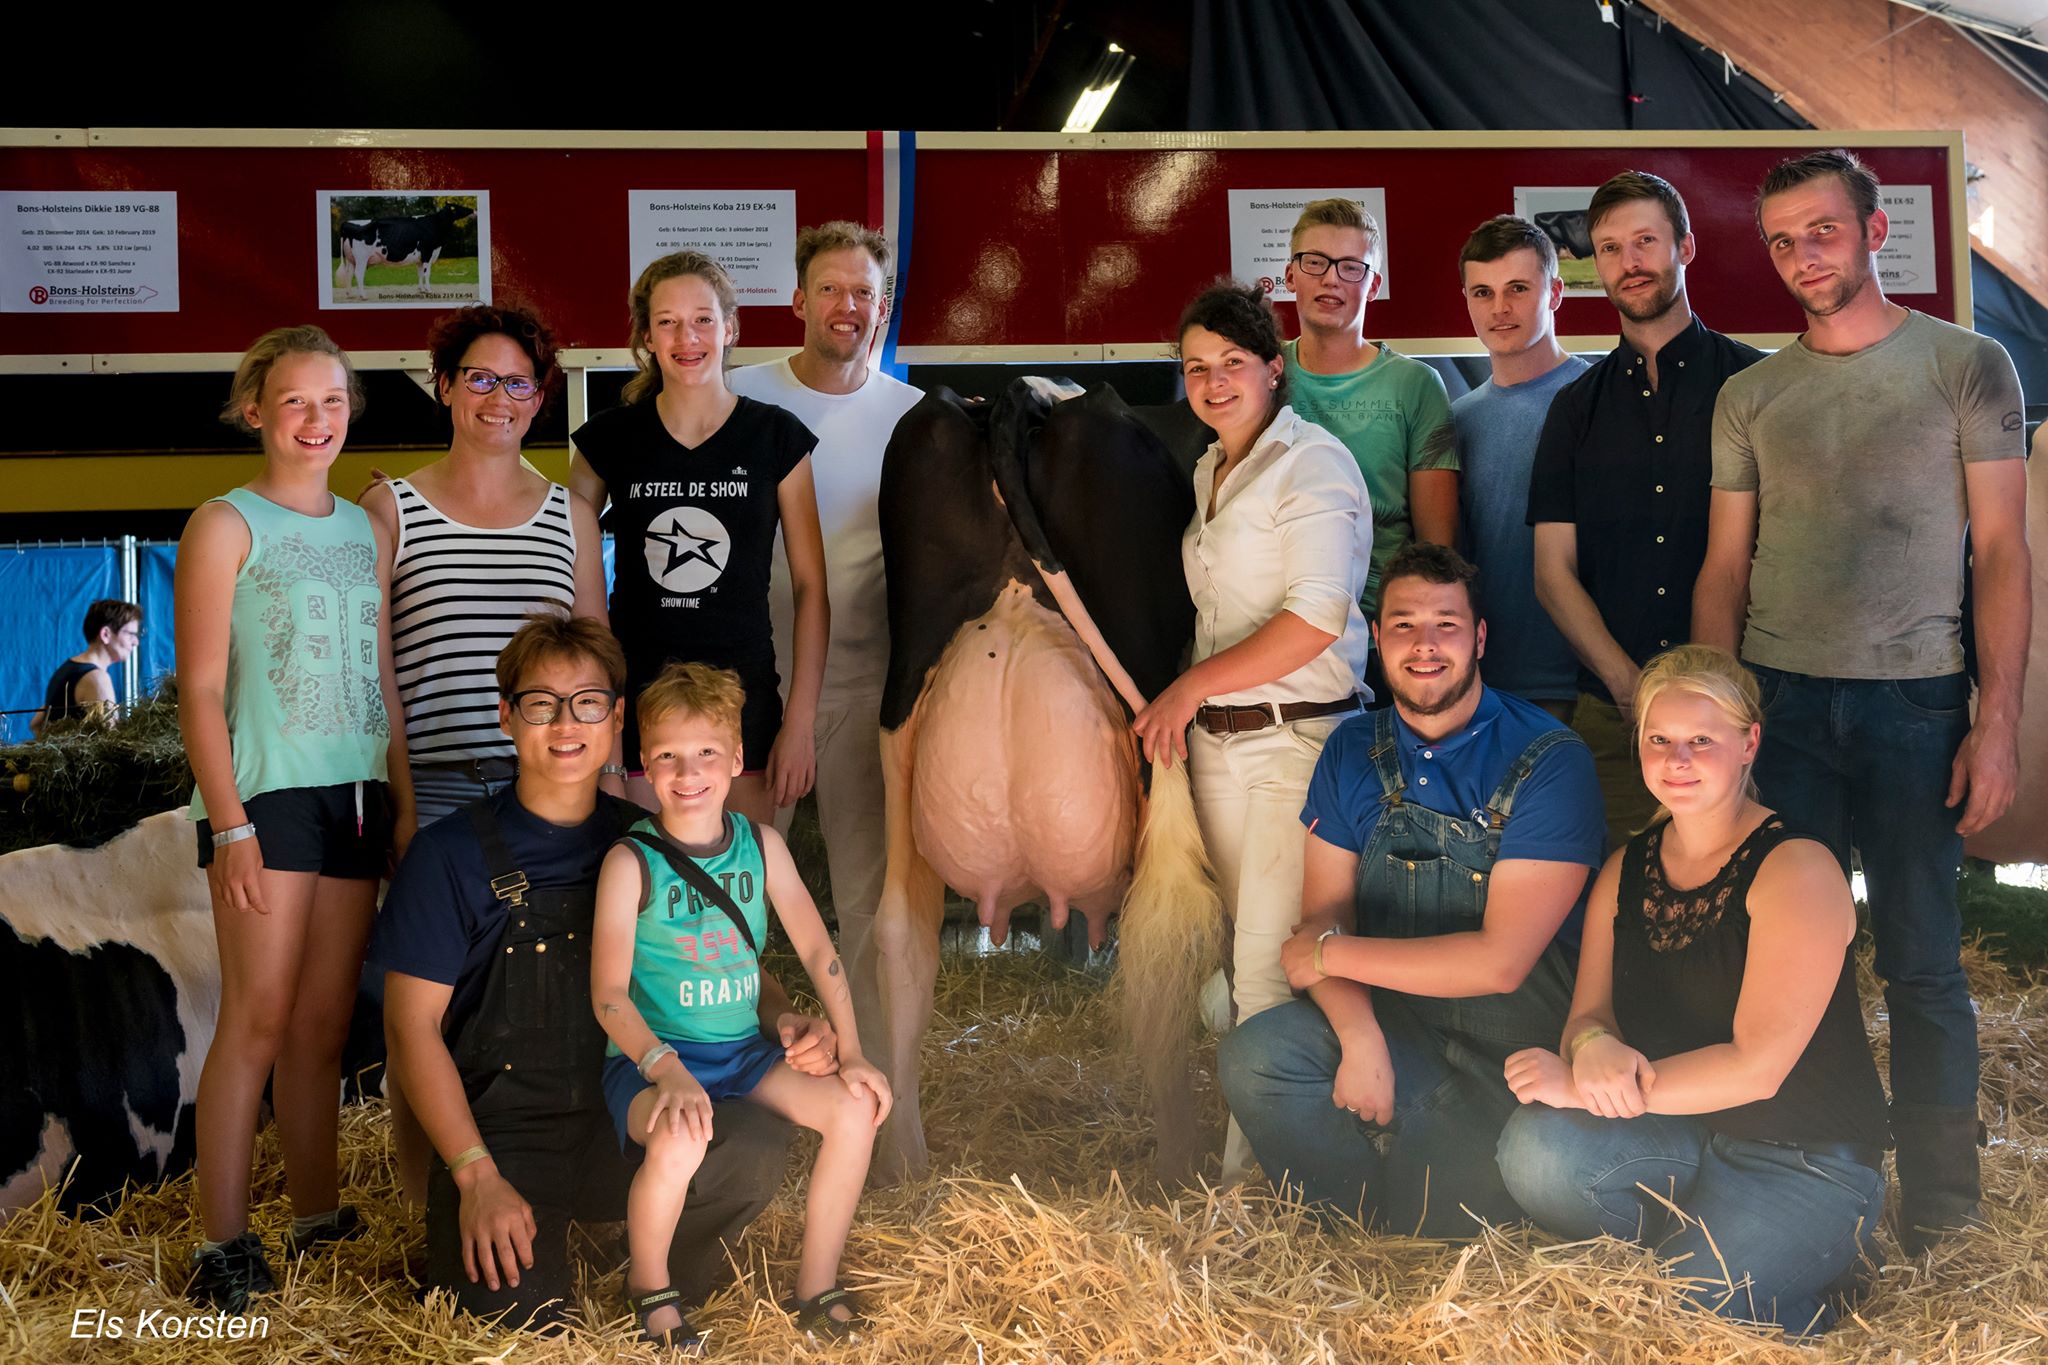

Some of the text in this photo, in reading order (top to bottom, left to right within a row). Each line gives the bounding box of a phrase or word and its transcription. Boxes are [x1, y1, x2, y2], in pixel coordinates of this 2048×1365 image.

[17, 205, 160, 213] Bons-Holsteins Dikkie 189 VG-88
[650, 203, 776, 211] Bons-Holsteins Koba 219 EX-94
[50, 285, 135, 295] Bons-Holsteins
[630, 482, 748, 499] IK STEEL DE SHOW
[661, 597, 700, 609] SHOWTIME
